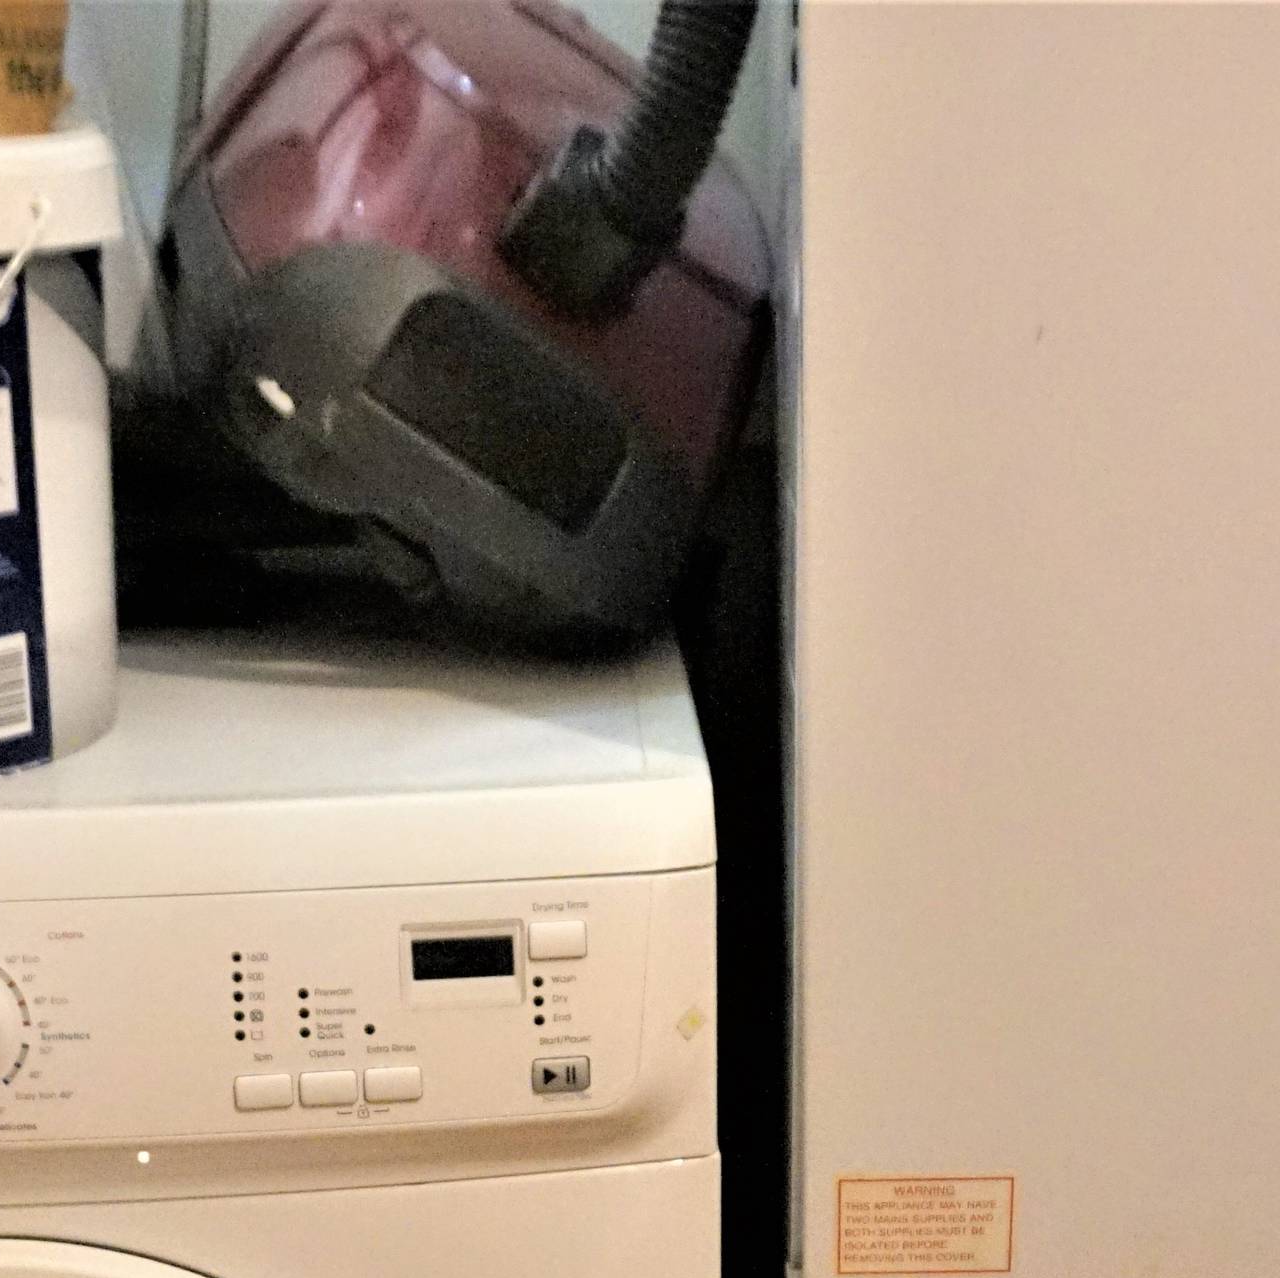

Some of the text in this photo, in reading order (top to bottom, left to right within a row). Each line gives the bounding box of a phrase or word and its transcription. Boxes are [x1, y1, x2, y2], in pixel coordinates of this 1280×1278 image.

[551, 975, 577, 984] Wash
[40, 1031, 91, 1042] Synthetics
[253, 1052, 273, 1063] Spin
[893, 1185, 955, 1197] WARNING
[844, 1200, 998, 1211] THIS APPLIANCE MAY HAVE
[845, 1213, 994, 1225] TWO MAINS SUPPLIES AND
[844, 1228, 875, 1237] BOTH
[879, 1227, 933, 1237] SUPPLIES
[936, 1227, 967, 1236] MUST
[844, 1240, 947, 1250] ISOLATED BEFORE
[844, 1252, 975, 1263] REMOVING THIS COVER
